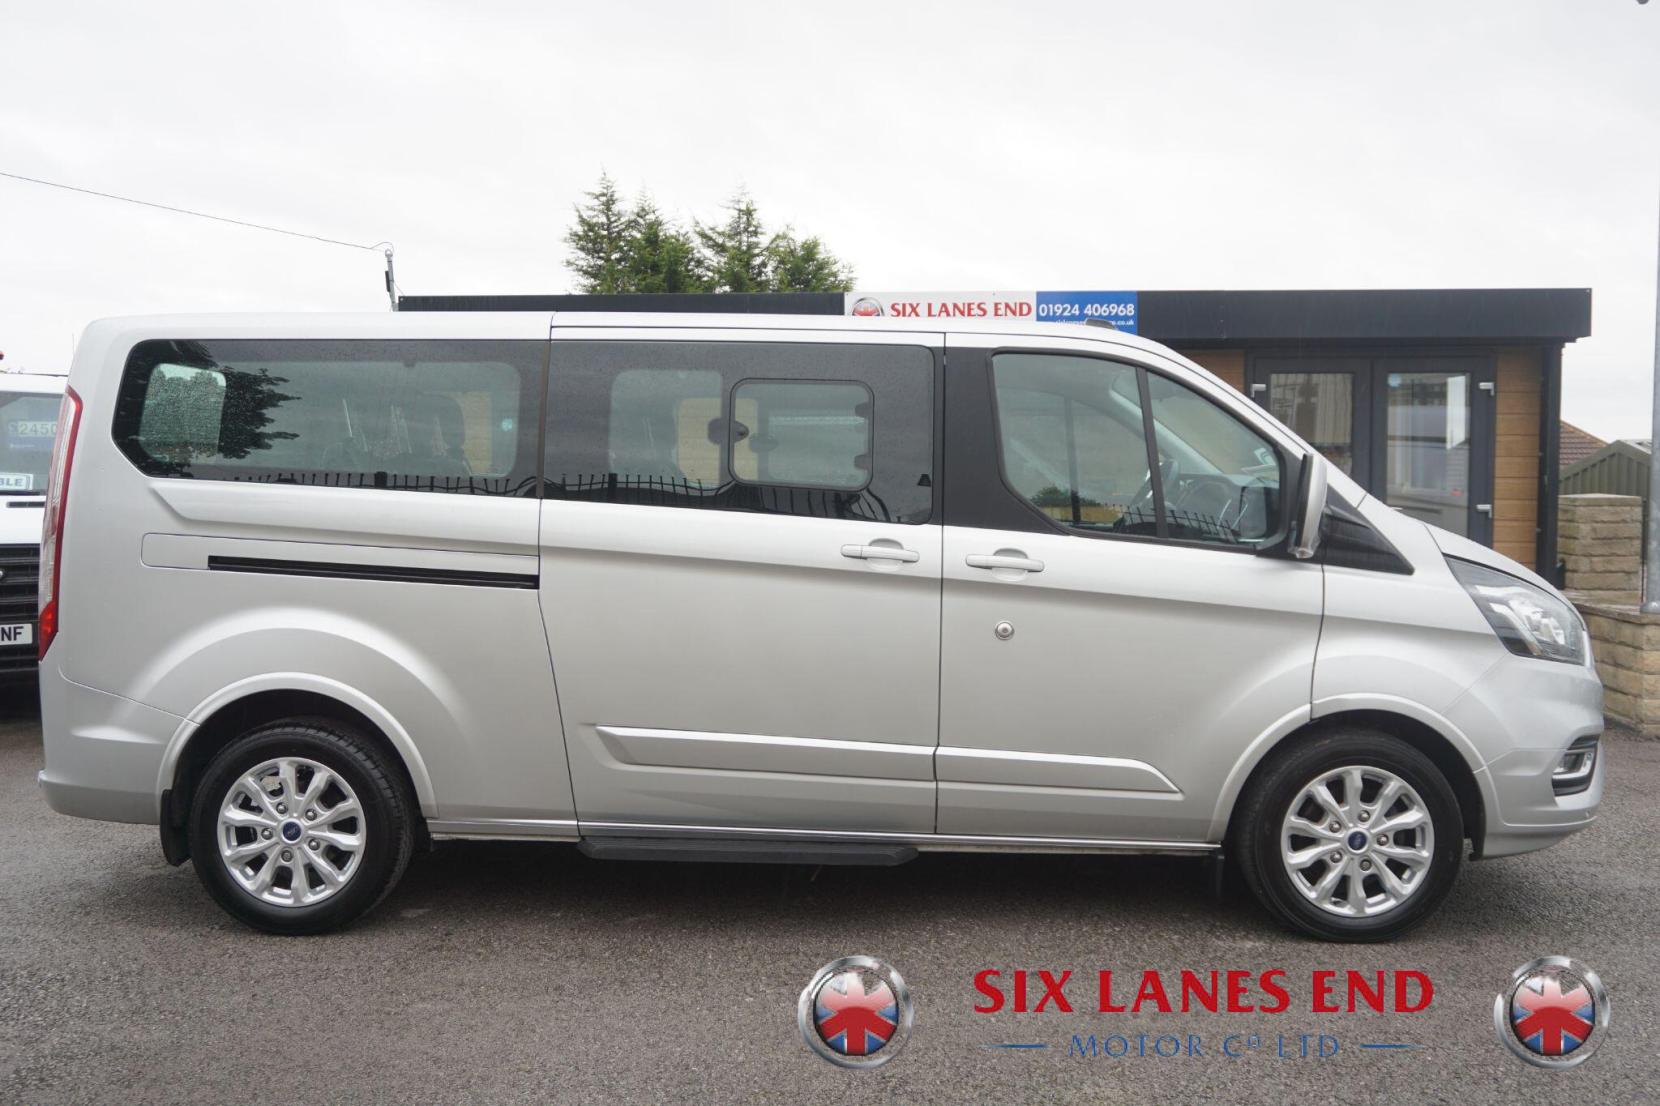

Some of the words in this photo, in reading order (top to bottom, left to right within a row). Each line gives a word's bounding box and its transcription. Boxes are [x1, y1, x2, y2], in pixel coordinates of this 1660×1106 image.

[890, 302, 920, 317] SIX
[927, 302, 988, 317] LANES
[993, 302, 1033, 317] END
[1039, 303, 1080, 316] 01924
[1083, 303, 1135, 316] 406968
